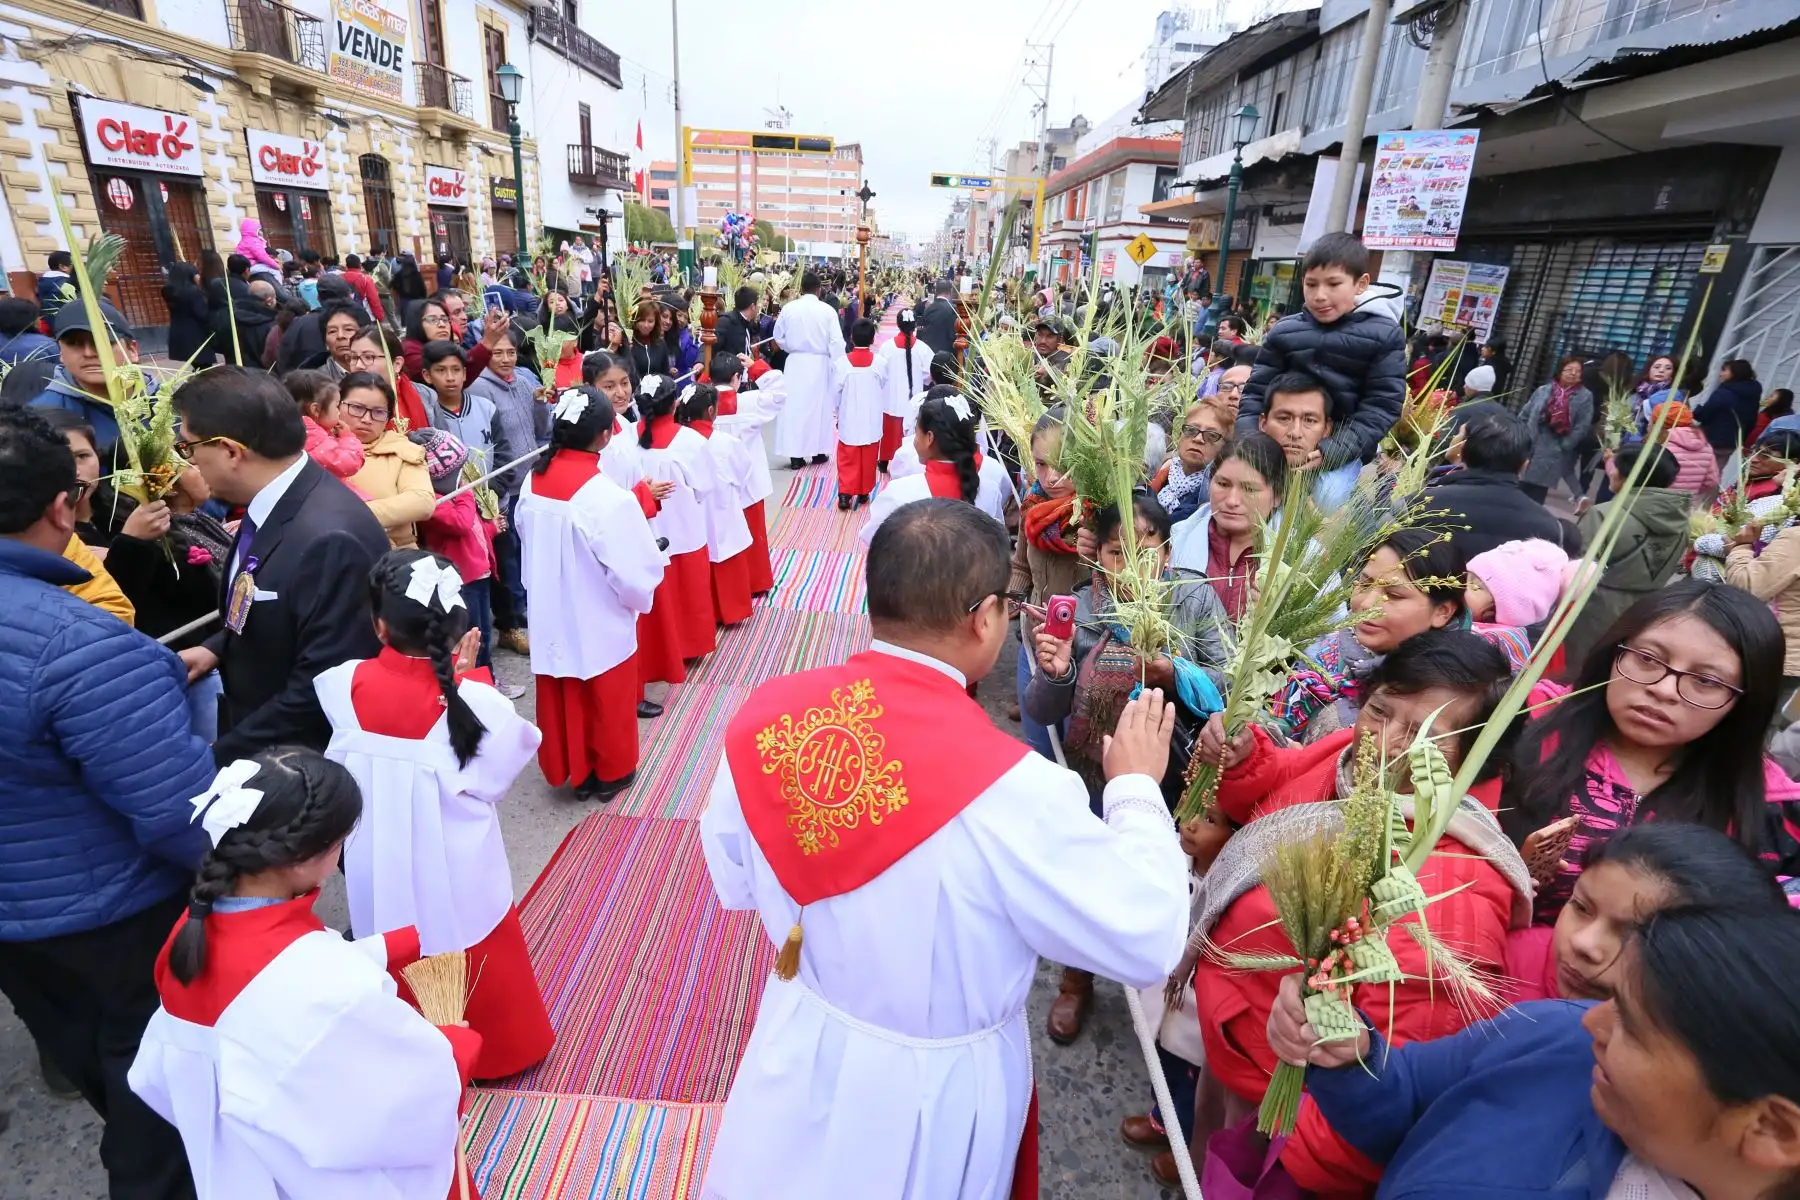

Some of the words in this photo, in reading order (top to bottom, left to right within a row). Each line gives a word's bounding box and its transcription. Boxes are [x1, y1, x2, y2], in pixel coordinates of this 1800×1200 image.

[337, 20, 403, 72] VENDE
[97, 116, 188, 160] Claro
[765, 120, 783, 129] HOTEL
[259, 143, 319, 177] Claro
[429, 174, 463, 198] Claro
